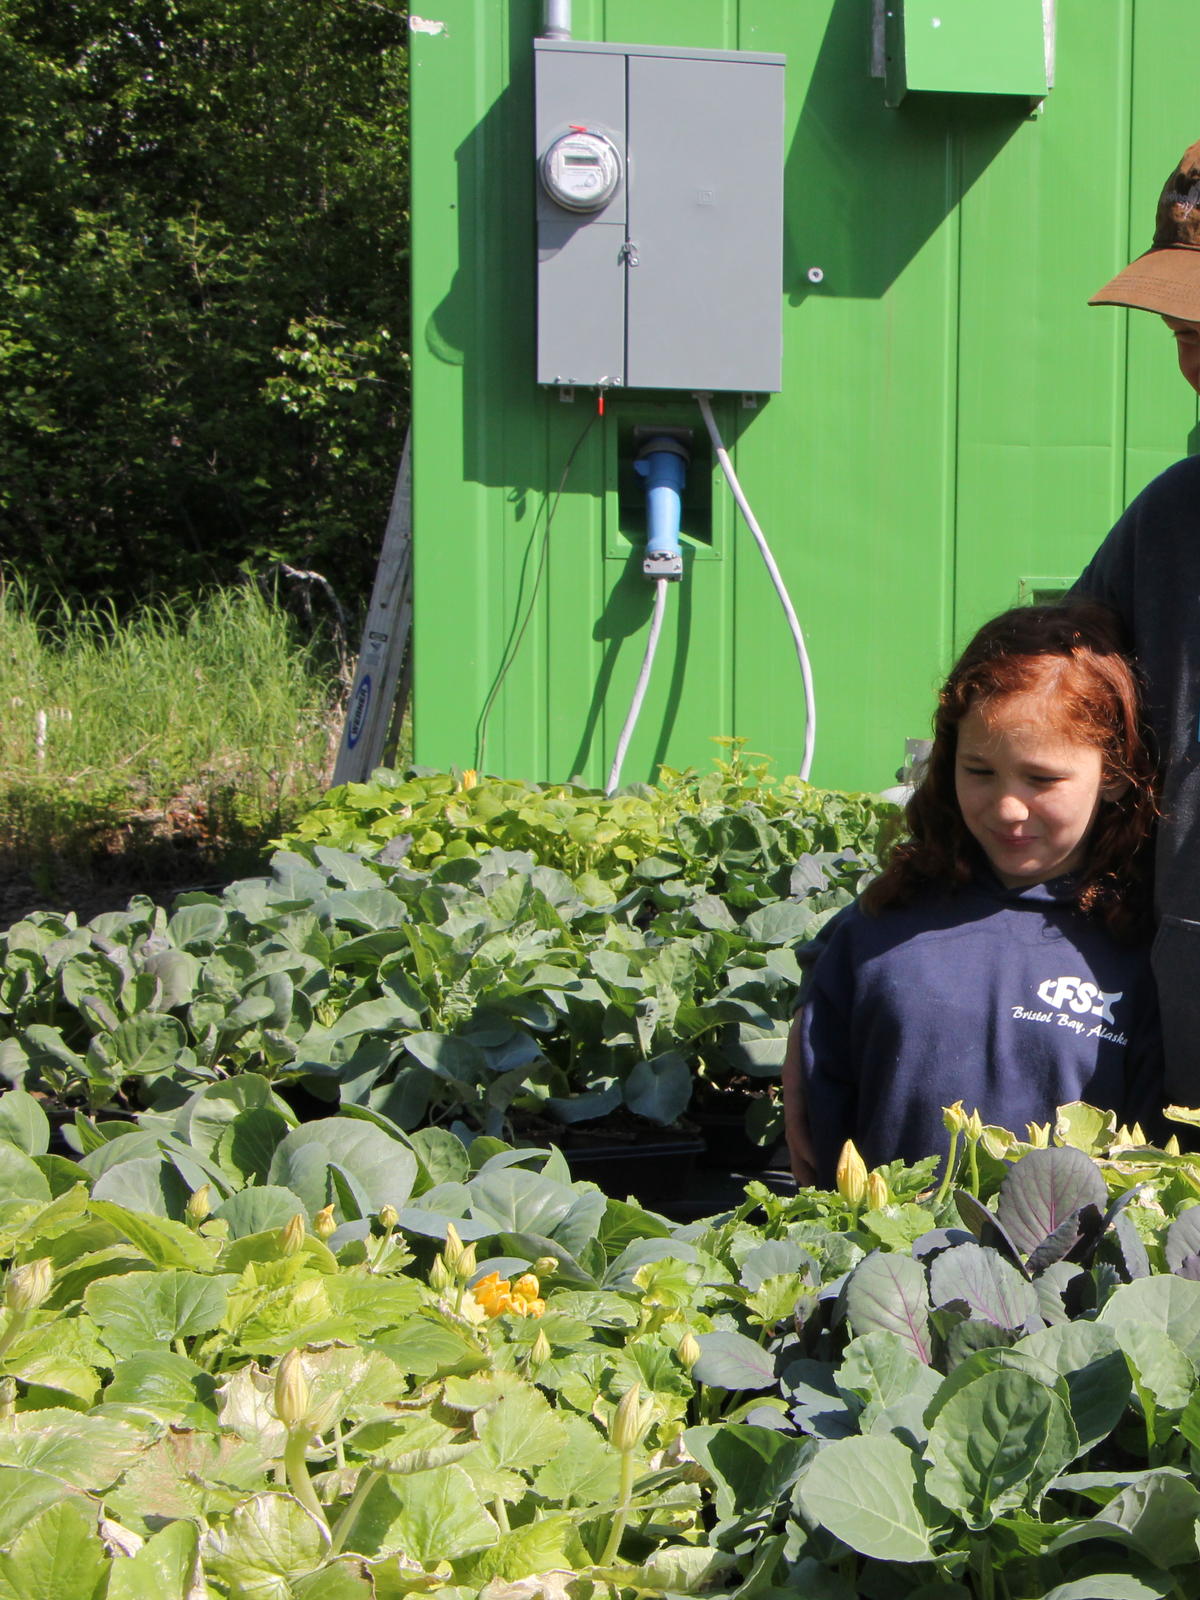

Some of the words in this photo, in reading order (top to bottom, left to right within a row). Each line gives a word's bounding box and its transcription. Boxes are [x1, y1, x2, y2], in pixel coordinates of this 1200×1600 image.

[1011, 1006, 1054, 1023] Bristol
[1056, 1013, 1086, 1034] Bay,
[1086, 1023, 1129, 1047] Alaska
